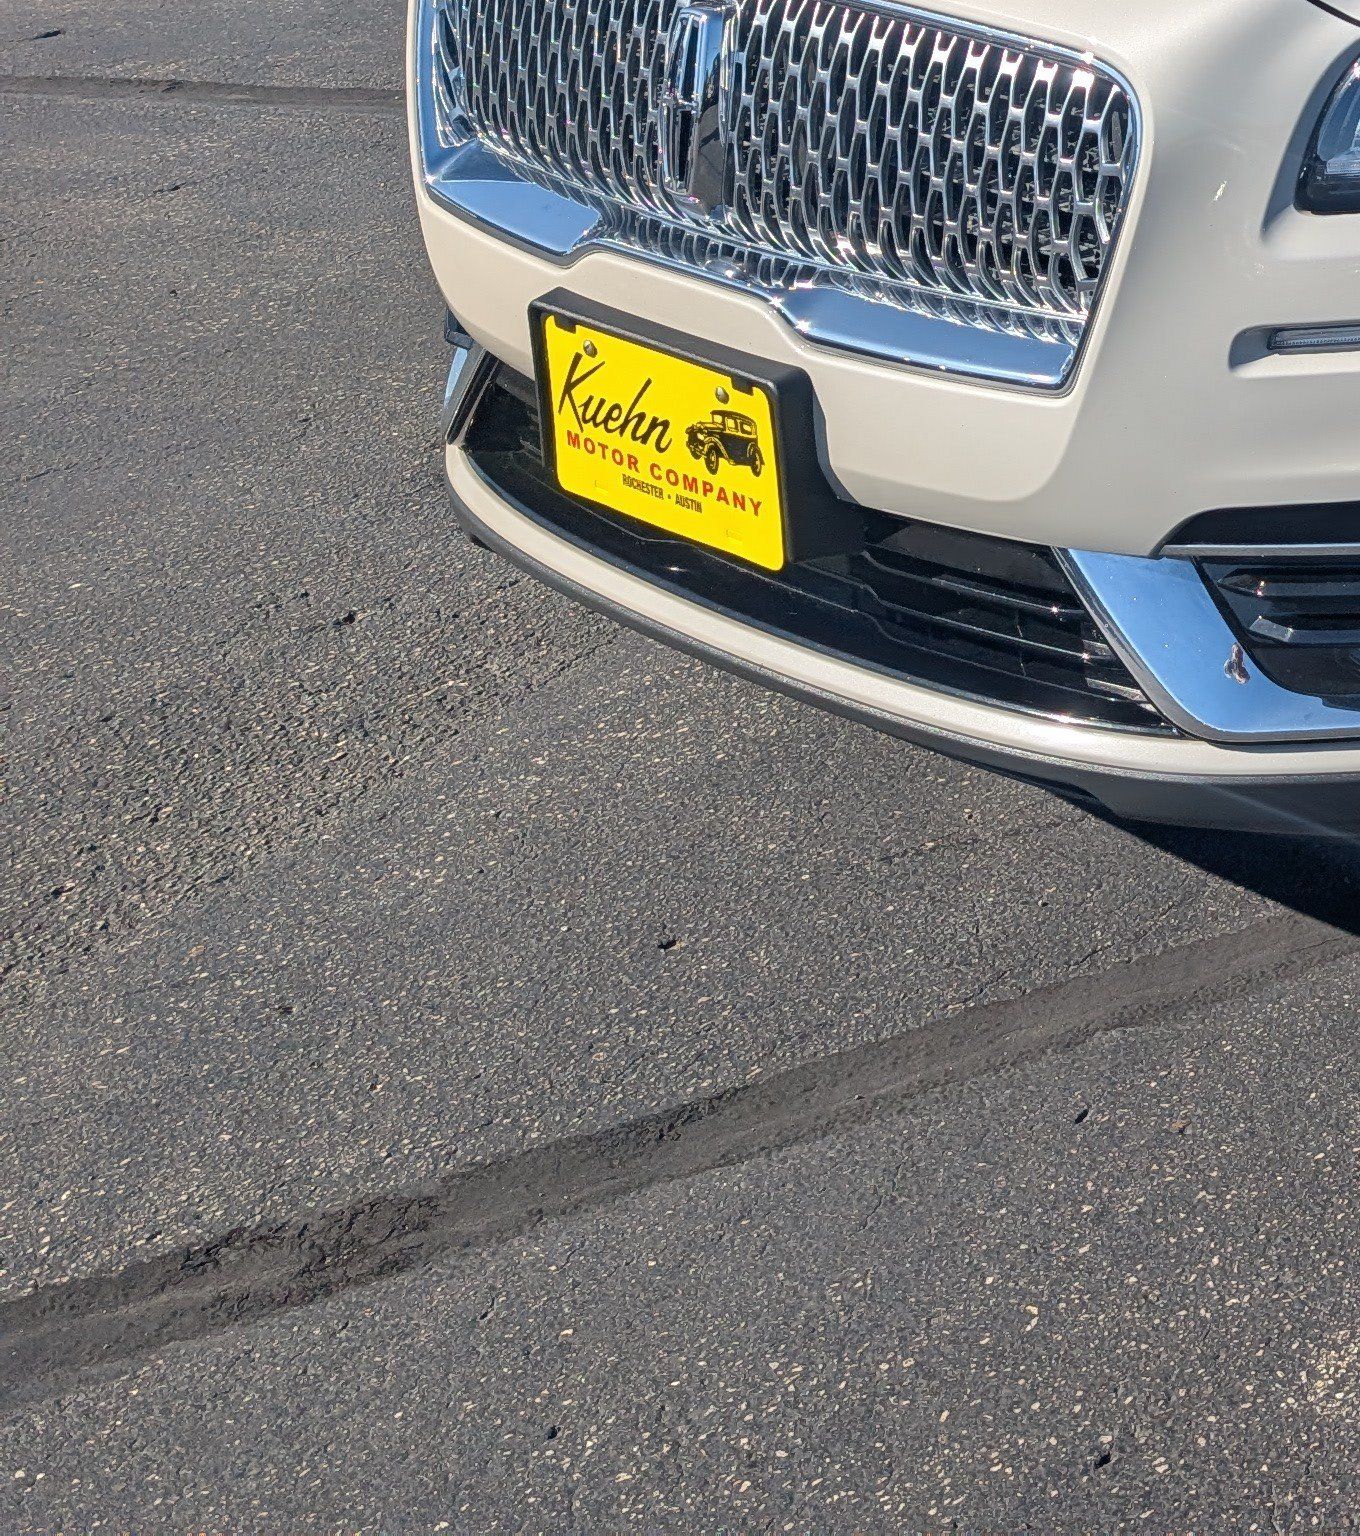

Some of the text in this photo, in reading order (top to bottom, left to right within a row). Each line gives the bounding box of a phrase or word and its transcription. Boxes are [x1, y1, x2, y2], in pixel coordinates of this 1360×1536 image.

[558, 351, 673, 454] Kuehn
[566, 429, 763, 517] MOTOR COMPANY
[621, 473, 703, 514] ROCHESTER AUSTIN
